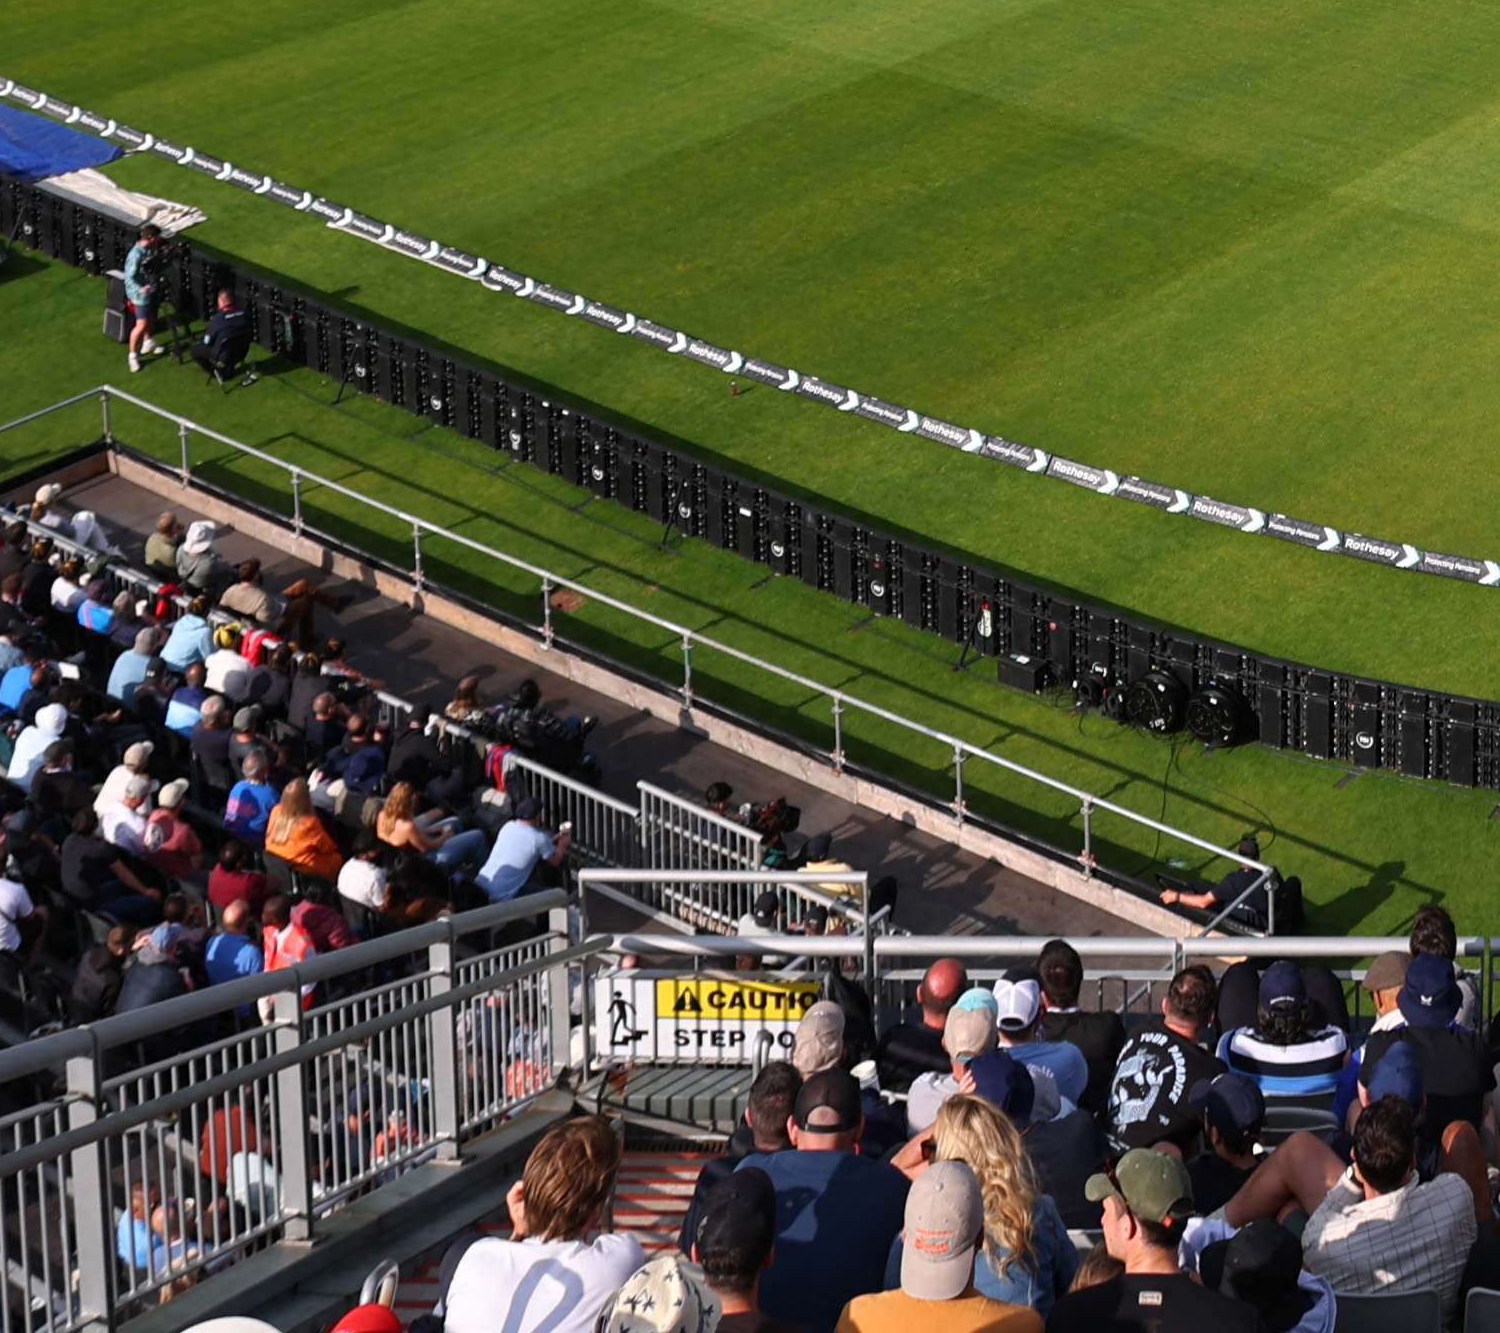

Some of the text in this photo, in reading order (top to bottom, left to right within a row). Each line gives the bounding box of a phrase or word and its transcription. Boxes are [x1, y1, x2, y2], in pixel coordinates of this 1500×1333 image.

[1053, 460, 1101, 486] Rothesay
[1194, 500, 1245, 524] Rothesay
[1345, 537, 1400, 560] Rothesay
[708, 990, 818, 1010] CAUTIO
[674, 1029, 745, 1048] STEP
[1140, 1032, 1187, 1105] YOUR PARADISE
